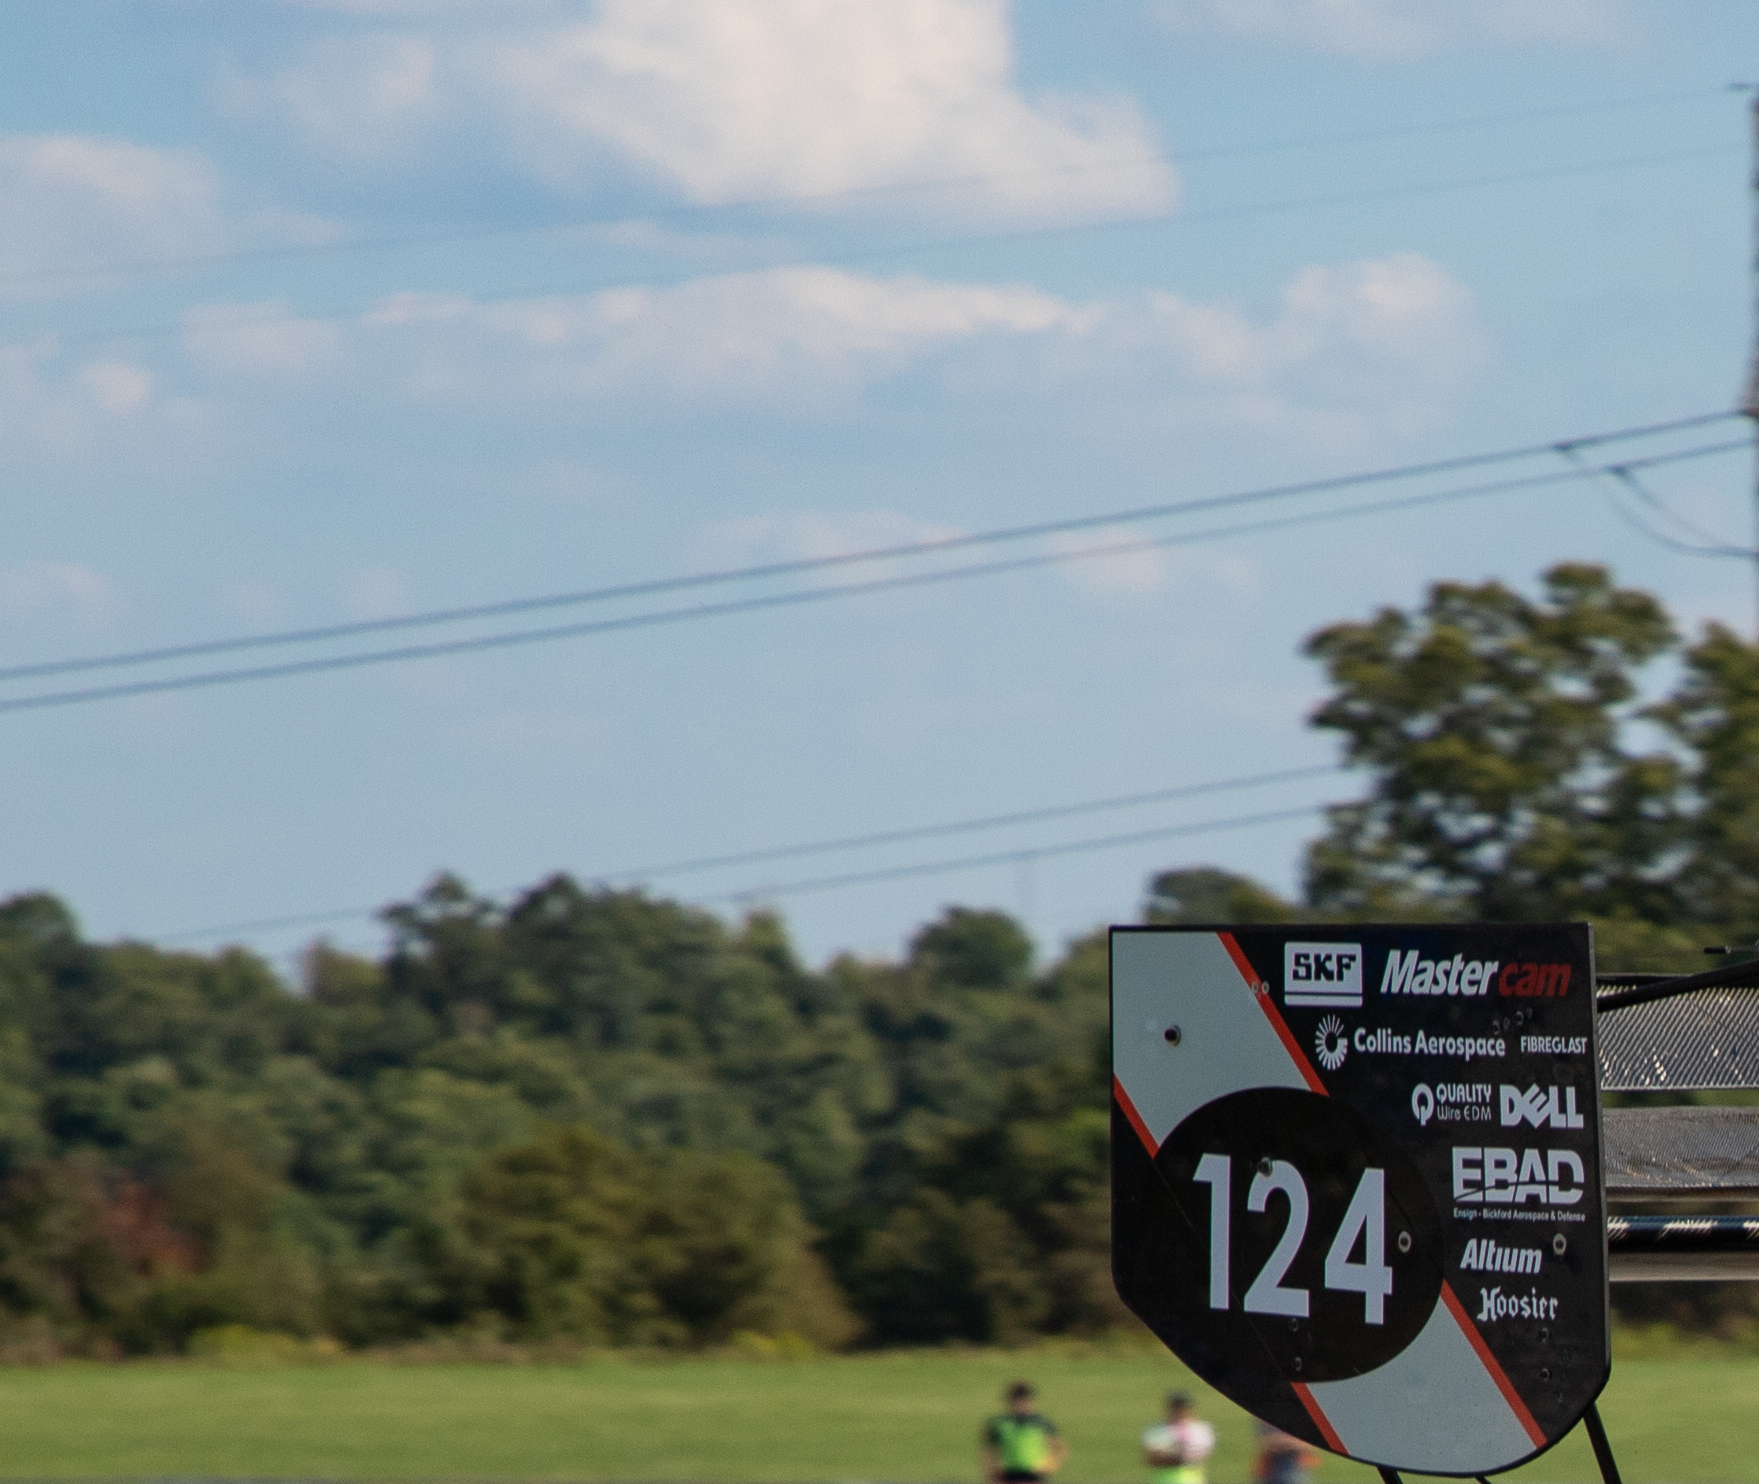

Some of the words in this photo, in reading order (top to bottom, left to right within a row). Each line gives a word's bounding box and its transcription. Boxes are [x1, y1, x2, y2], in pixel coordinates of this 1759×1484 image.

[1292, 953, 1356, 982] SKF
[1380, 948, 1571, 997] Mastercam
[1354, 1026, 1411, 1054] Collins
[1414, 1029, 1505, 1061] Aerospace
[1520, 1035, 1587, 1055] FIBREGLAST
[1436, 1083, 1492, 1104] QUALITY
[1499, 1082, 1584, 1129] DELL
[1436, 1105, 1461, 1121] Wire
[1463, 1105, 1492, 1121] EDM
[1452, 1146, 1585, 1205] EBAD
[1192, 1152, 1392, 1325] 124
[1477, 1285, 1559, 1322] Hoosier
